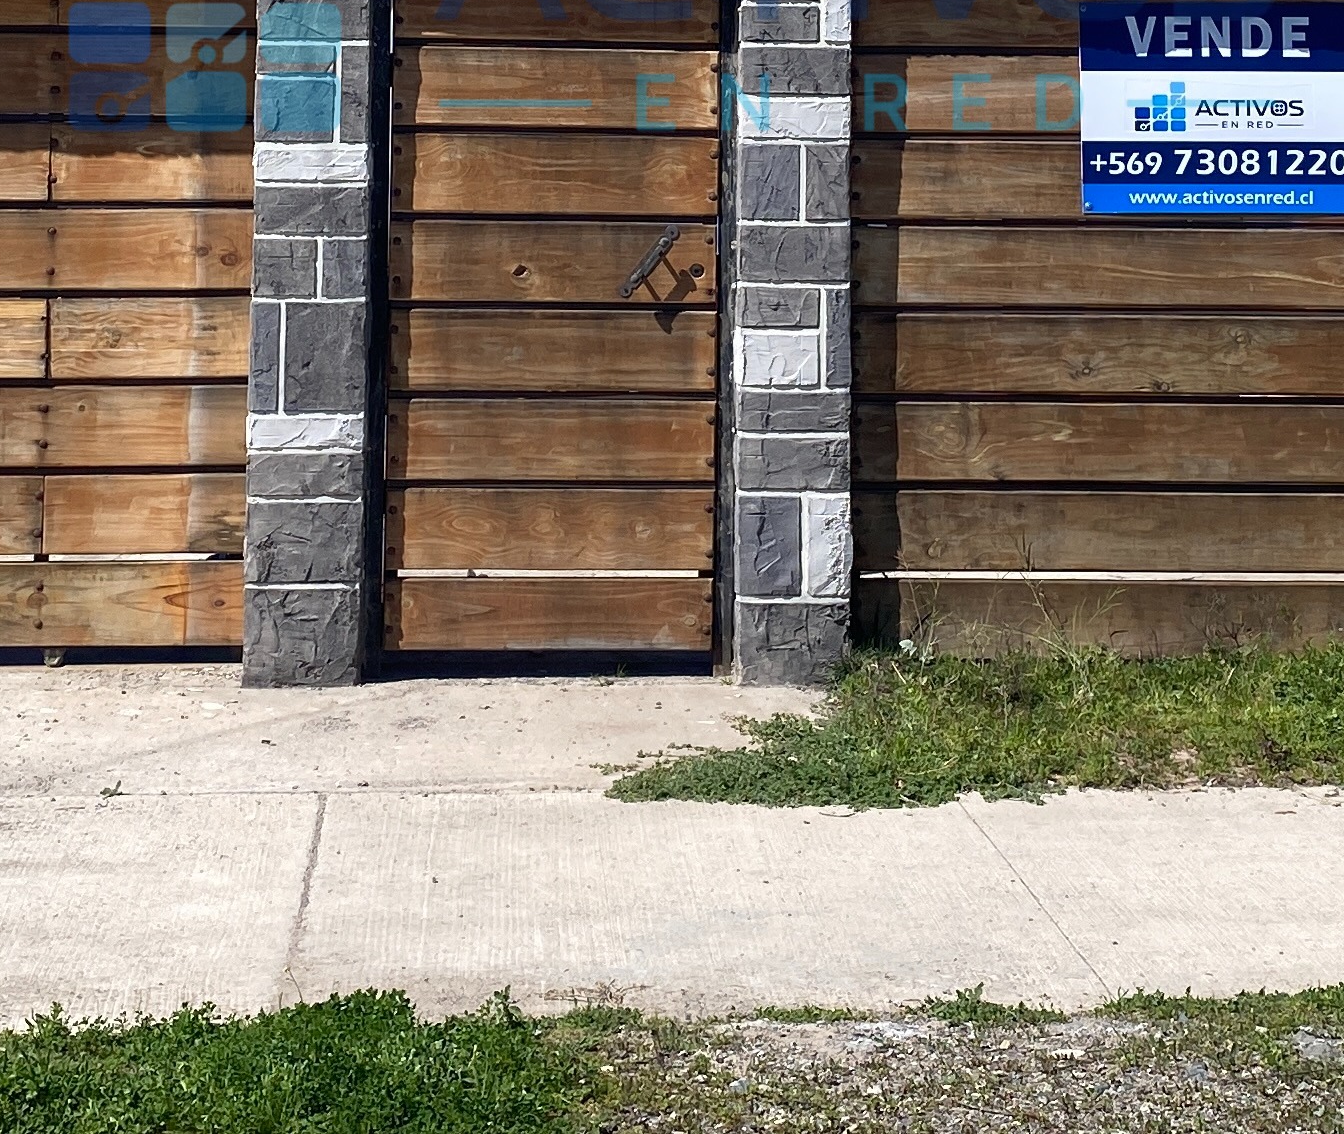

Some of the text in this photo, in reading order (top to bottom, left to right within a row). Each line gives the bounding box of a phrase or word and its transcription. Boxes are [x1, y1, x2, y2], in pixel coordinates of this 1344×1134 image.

[1125, 15, 1311, 57] VENDE
[1194, 99, 1305, 117] ACTIVOS
[1222, 121, 1274, 129] EN RED
[1090, 151, 1163, 176] +569
[1129, 190, 1314, 205] www.activosenred.cl
